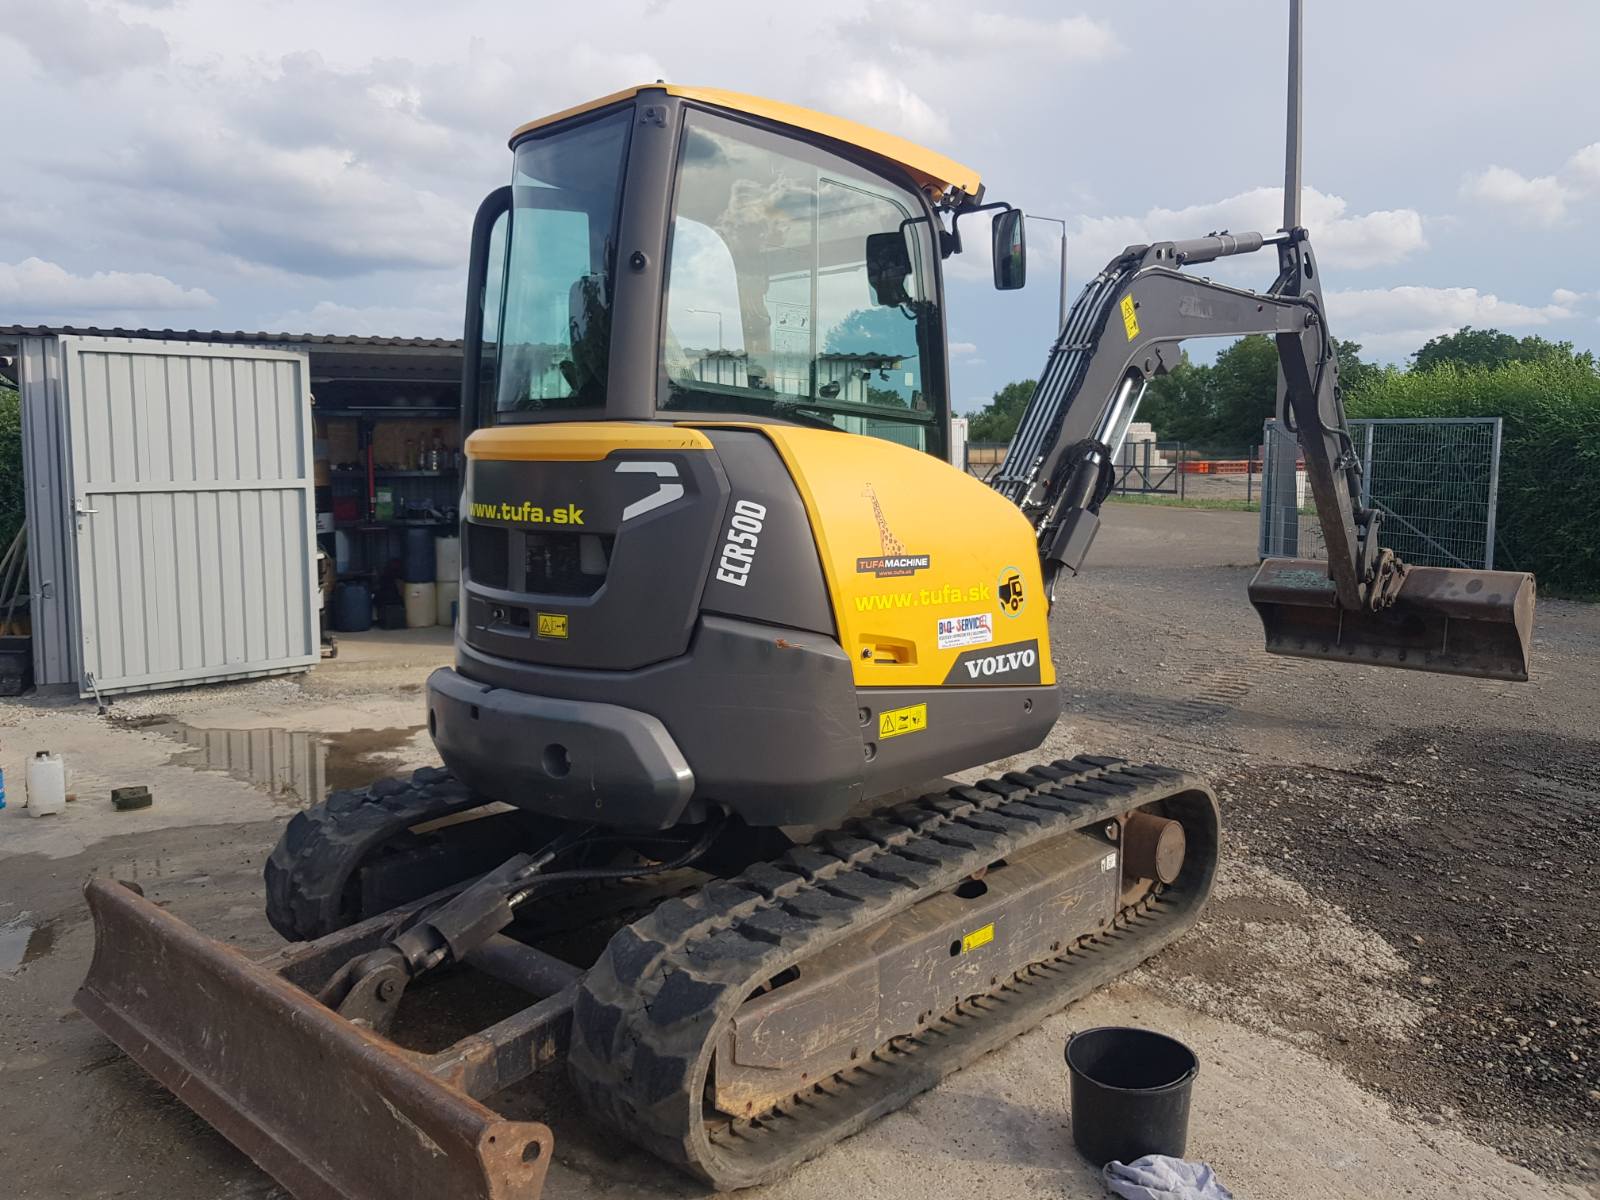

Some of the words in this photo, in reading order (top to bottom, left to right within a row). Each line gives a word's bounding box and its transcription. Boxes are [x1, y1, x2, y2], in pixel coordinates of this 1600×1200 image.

[469, 501, 584, 525] www.tufa.sk
[716, 500, 766, 587] ECR50D
[859, 557, 928, 569] TUFAMACHINE
[855, 584, 990, 611] www.tufa.sk
[965, 648, 1035, 679] VOLVO
